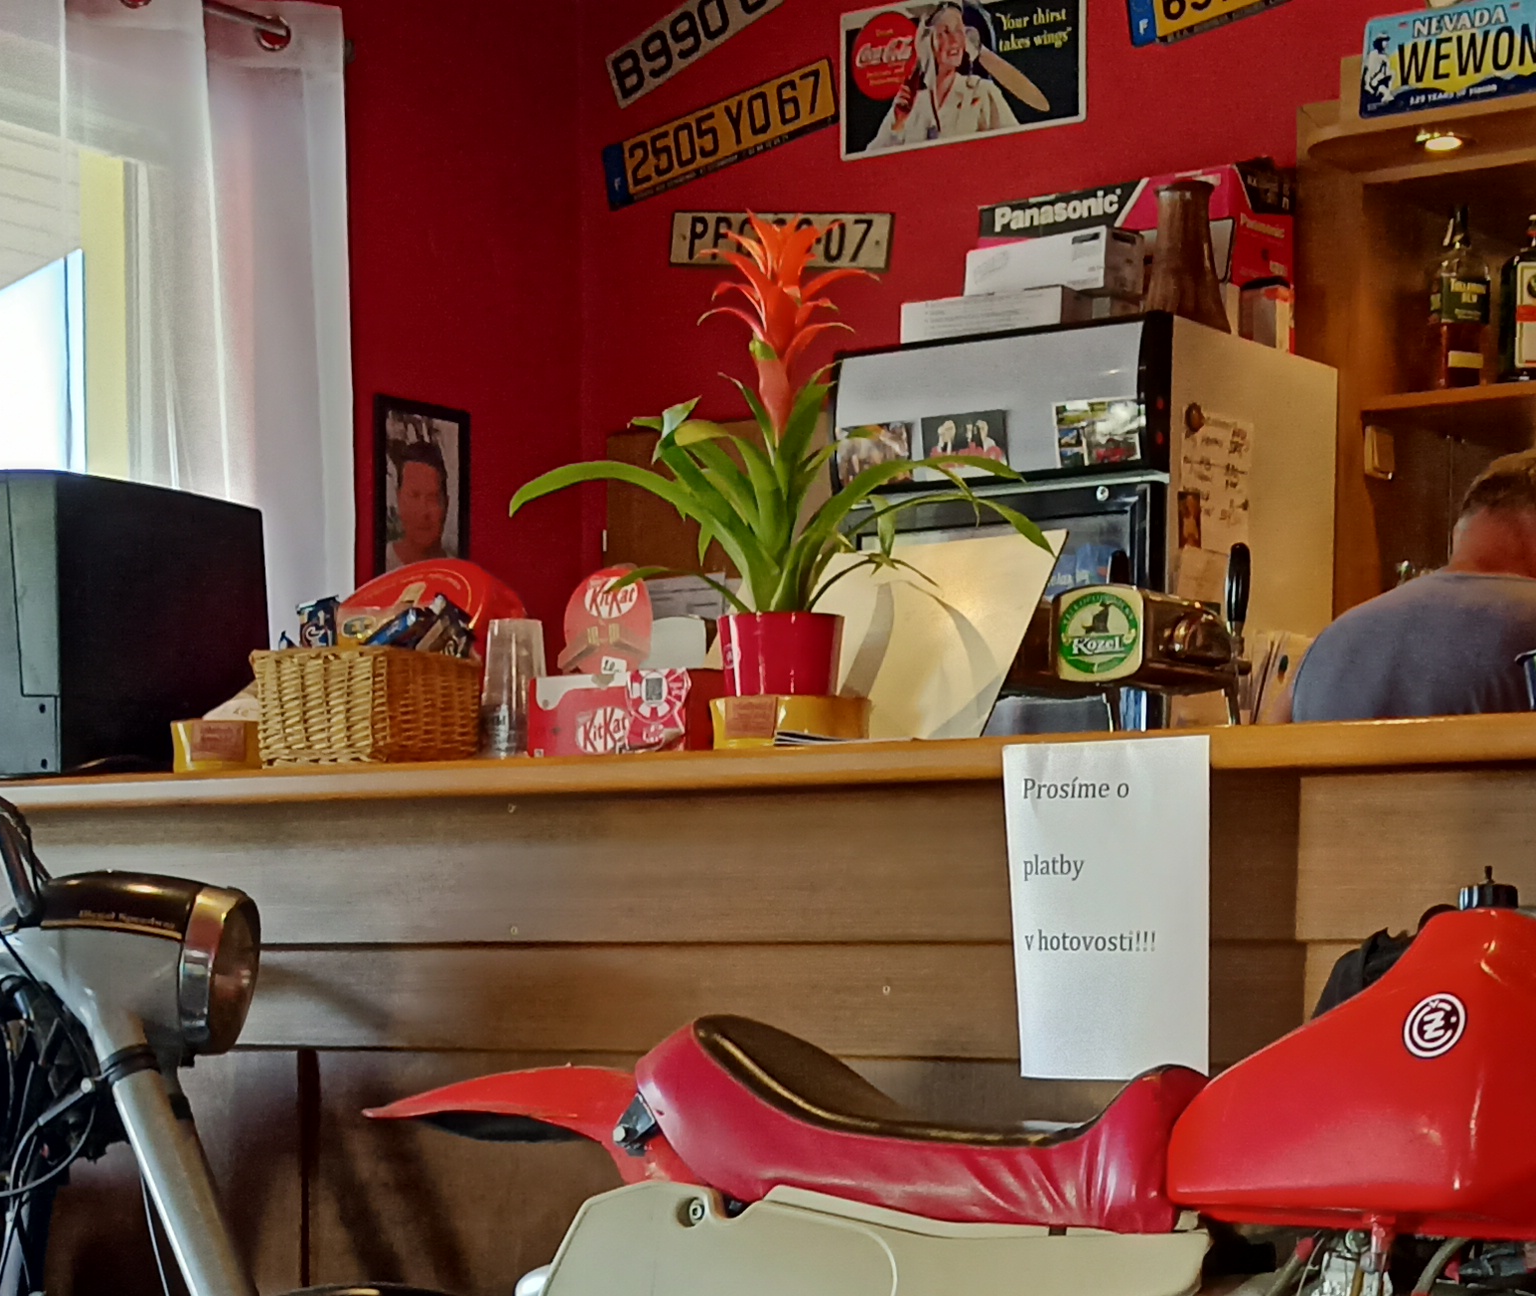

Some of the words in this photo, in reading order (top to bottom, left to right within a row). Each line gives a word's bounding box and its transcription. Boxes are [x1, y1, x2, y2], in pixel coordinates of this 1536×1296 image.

[1033, 7, 1067, 25] thirst
[1138, 18, 1149, 35] F
[1413, 4, 1508, 38] NEVADA
[999, 34, 1031, 52] takes
[628, 112, 720, 188] 2505
[776, 68, 821, 127] 67
[993, 188, 1122, 233] Panasonic
[589, 583, 636, 618] KitKat
[1072, 636, 1121, 656] Kozel
[582, 706, 630, 753] KitKat
[1022, 777, 1111, 800] Prosíme
[1116, 781, 1130, 799] o
[1022, 854, 1085, 881] platby
[1024, 933, 1034, 951] v
[1037, 930, 1157, 952] hotovosti!!!
